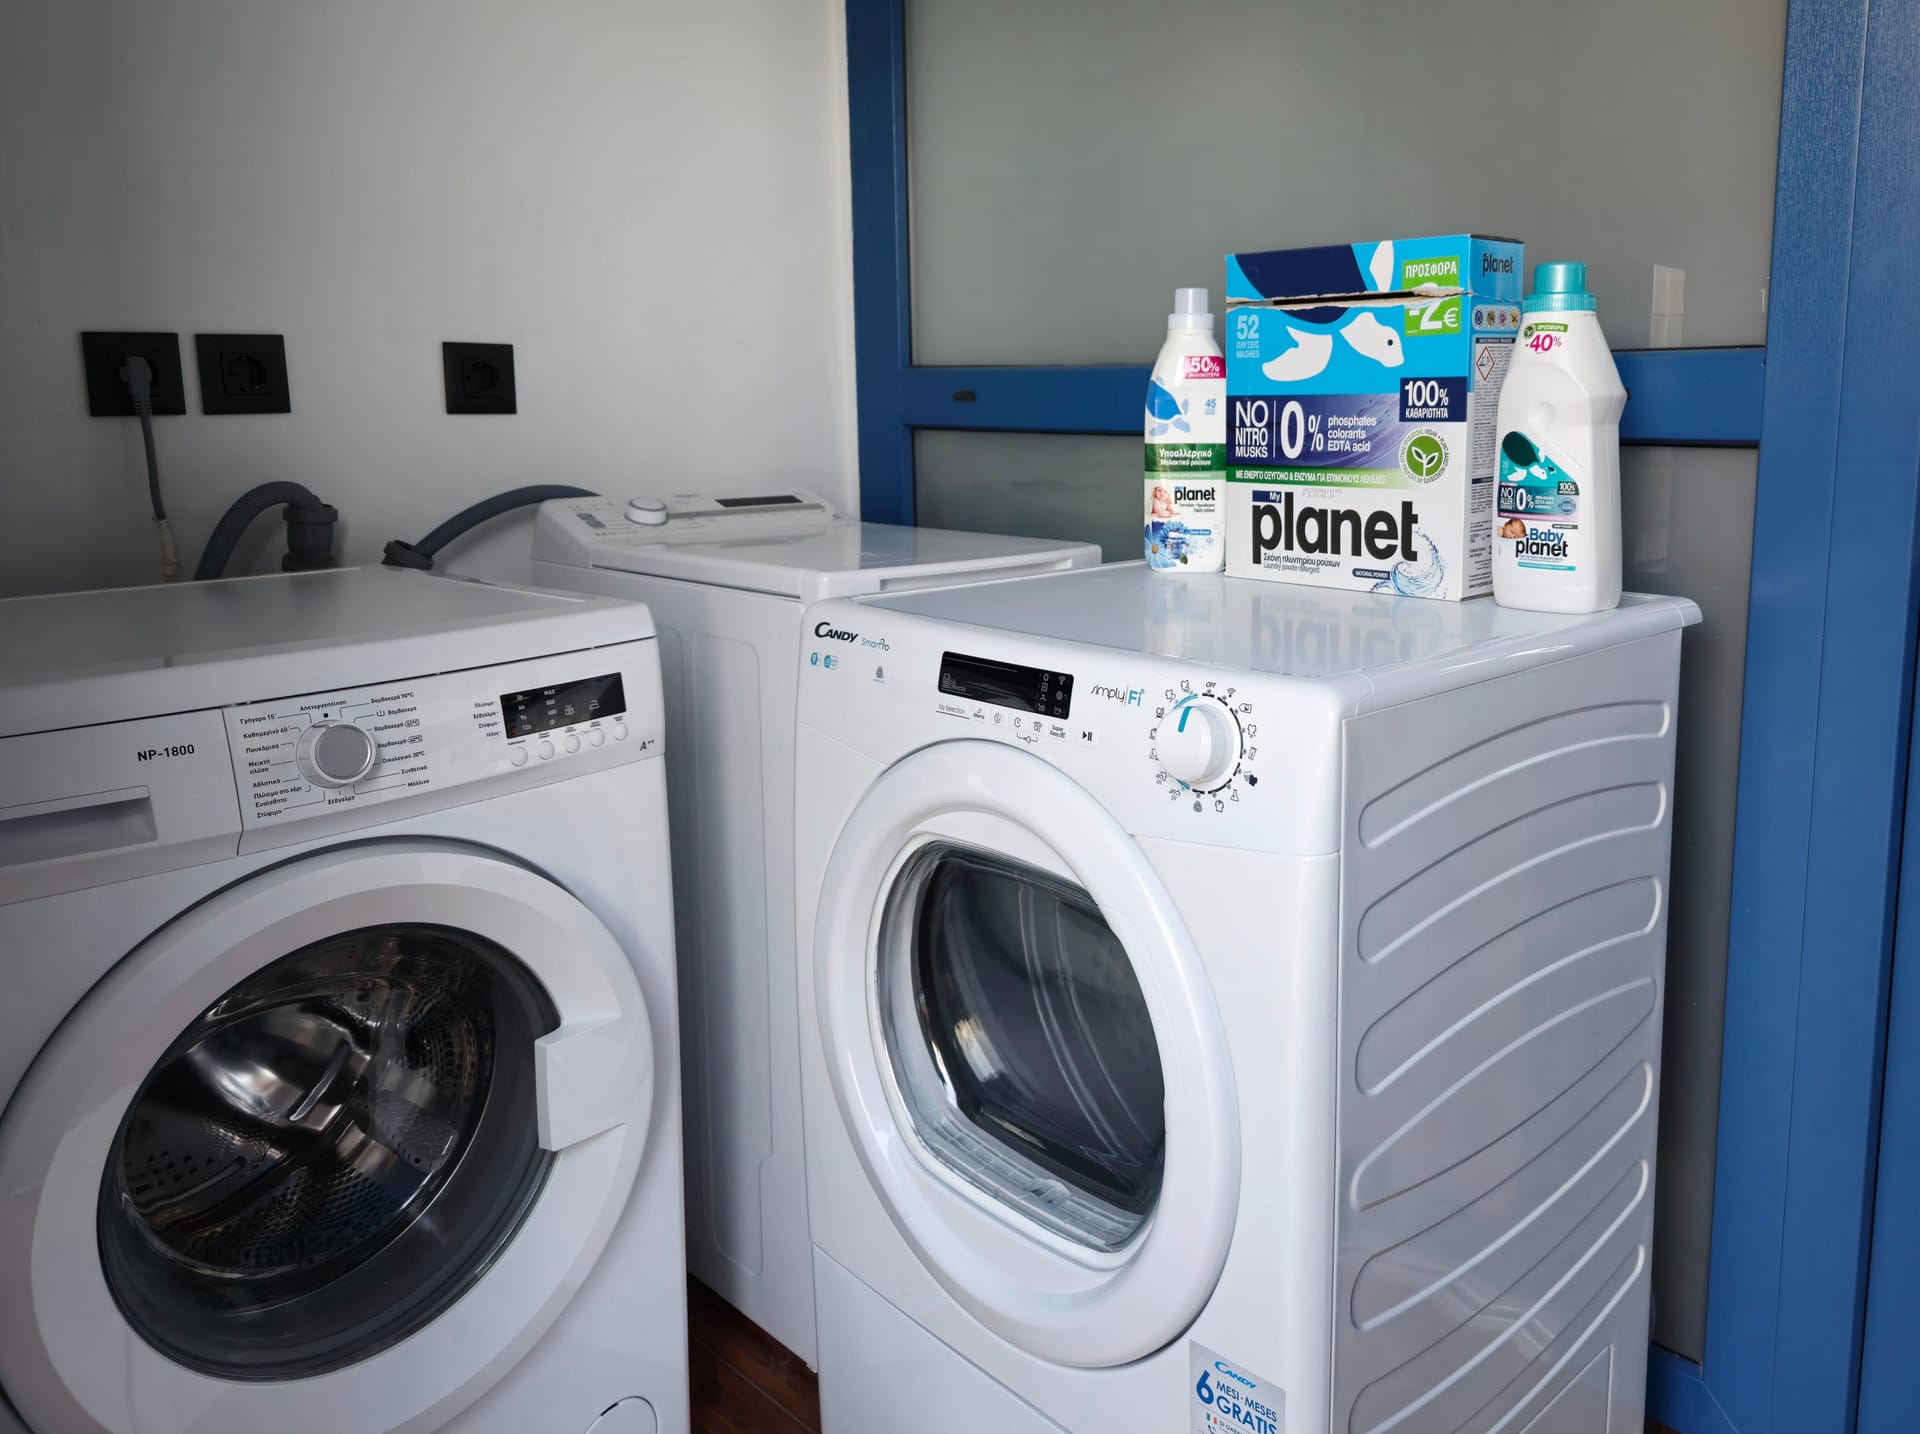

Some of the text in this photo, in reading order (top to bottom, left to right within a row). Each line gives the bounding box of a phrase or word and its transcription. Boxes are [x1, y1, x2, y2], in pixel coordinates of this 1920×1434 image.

[1405, 260, 1457, 279] ΠΡΟΣΦΟΡΑ
[1482, 253, 1514, 276] planet
[1237, 314, 1260, 340] 52
[1525, 334, 1562, 352] -40%
[1236, 350, 1260, 359] WASHES
[1404, 380, 1449, 407] 100%
[1205, 398, 1217, 409] 45
[1235, 400, 1269, 428] NO
[1405, 406, 1448, 420] ΚΑΘΑΡΙΟΤΗΤΑ
[1327, 415, 1377, 427] phosphates
[1235, 427, 1269, 447] NITRO
[1280, 400, 1324, 460] 0%
[1327, 428, 1366, 440] colorants
[1159, 447, 1213, 459] Υποαλλεργικό
[1235, 444, 1268, 459] MUSKS
[1327, 440, 1371, 453] EDTA acid
[1235, 470, 1244, 479] ΜΕ
[1243, 470, 1264, 480] ΕΝΕΡΓΟ
[1264, 471, 1289, 481] ΟΞΥΓΟΝΟ
[1294, 472, 1316, 482] ΕΝΖΥΜΑ
[1316, 473, 1326, 482] ΓΙΑ
[1326, 474, 1360, 483] ΕΠΙΜΟΝΟΥΣ
[1360, 474, 1387, 485] ΛΕΚΕΔΕΣ
[1174, 486, 1216, 505] planet
[1269, 492, 1281, 503] My
[1501, 487, 1514, 499] NO
[1252, 491, 1419, 564] planet
[1529, 527, 1565, 545] Baby
[1515, 537, 1569, 558] planet
[1263, 552, 1341, 568] Σκόνη πλυντηρίου ρούχων
[1263, 561, 1320, 575] Laundry powder detergent
[1205, 681, 1217, 689] OFF
[299, 699, 348, 713] Απενεργοποίηση
[137, 744, 195, 762] NP-1800
[245, 743, 280, 754] Πουκάμισα
[253, 790, 279, 800] Πλύσιμο
[255, 797, 288, 808] Ευαίσθητα
[257, 809, 282, 819] Στύψιμο
[1196, 1369, 1214, 1405] 6
[1216, 1380, 1278, 1423] MESI MESES
[1216, 1395, 1278, 1434] GRATIS
